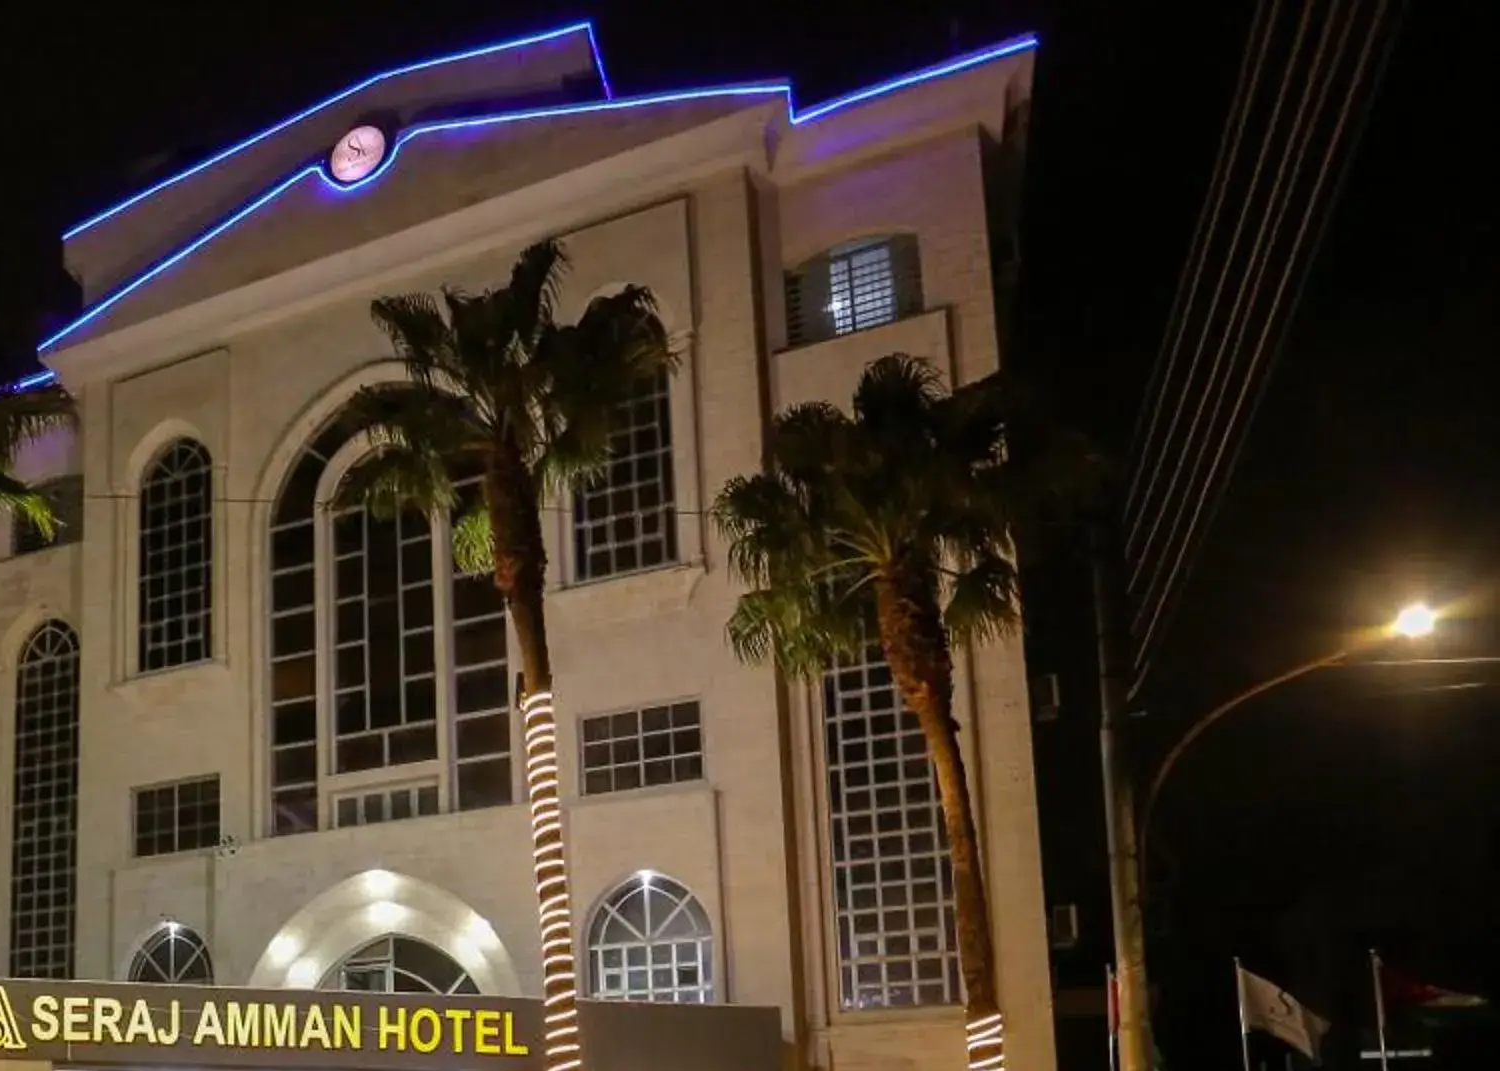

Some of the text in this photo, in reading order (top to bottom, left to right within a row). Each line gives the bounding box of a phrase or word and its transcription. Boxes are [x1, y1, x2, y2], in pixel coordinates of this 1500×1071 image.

[31, 995, 529, 1055] SERAJ AMMAN HOTEL
